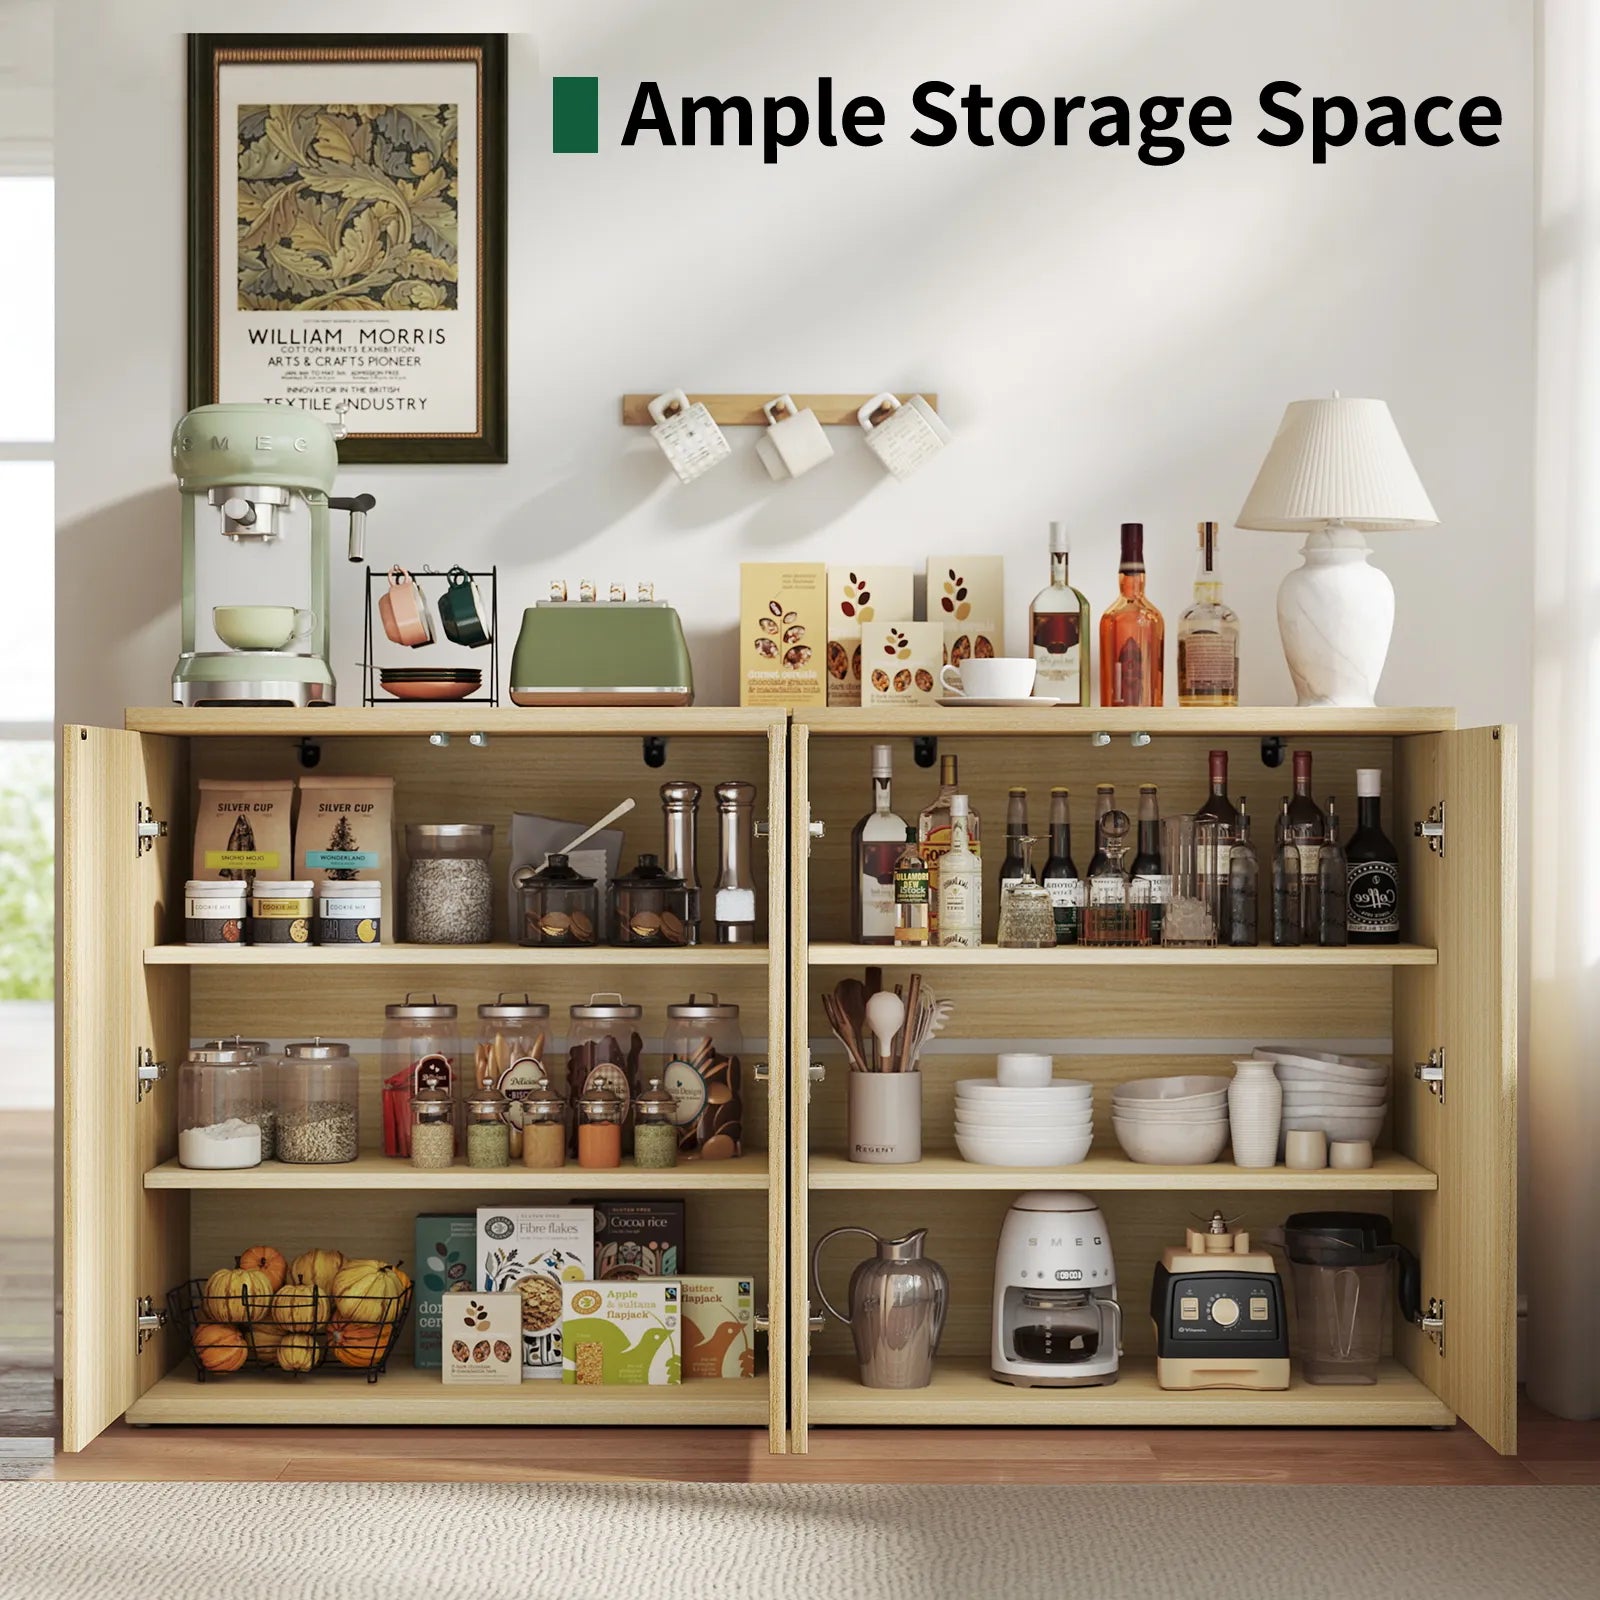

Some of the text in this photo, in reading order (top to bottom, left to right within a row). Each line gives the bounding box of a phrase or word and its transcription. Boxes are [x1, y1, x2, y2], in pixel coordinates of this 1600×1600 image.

[248, 328, 445, 344] WILLIAM MORRIS
[268, 356, 421, 366] ARTS & CRAFTS PIONEER
[217, 803, 273, 812] SILVER CUP
[319, 804, 374, 812] SILVER CUP
[611, 1217, 668, 1227] Cocoa rice
[520, 1222, 578, 1233] Fibre flakes
[1028, 1237, 1102, 1247] SMEG
[681, 1284, 714, 1292] Butter
[607, 1290, 638, 1299] Apple
[681, 1295, 722, 1304] flapjack
[607, 1311, 649, 1320] flapjack
